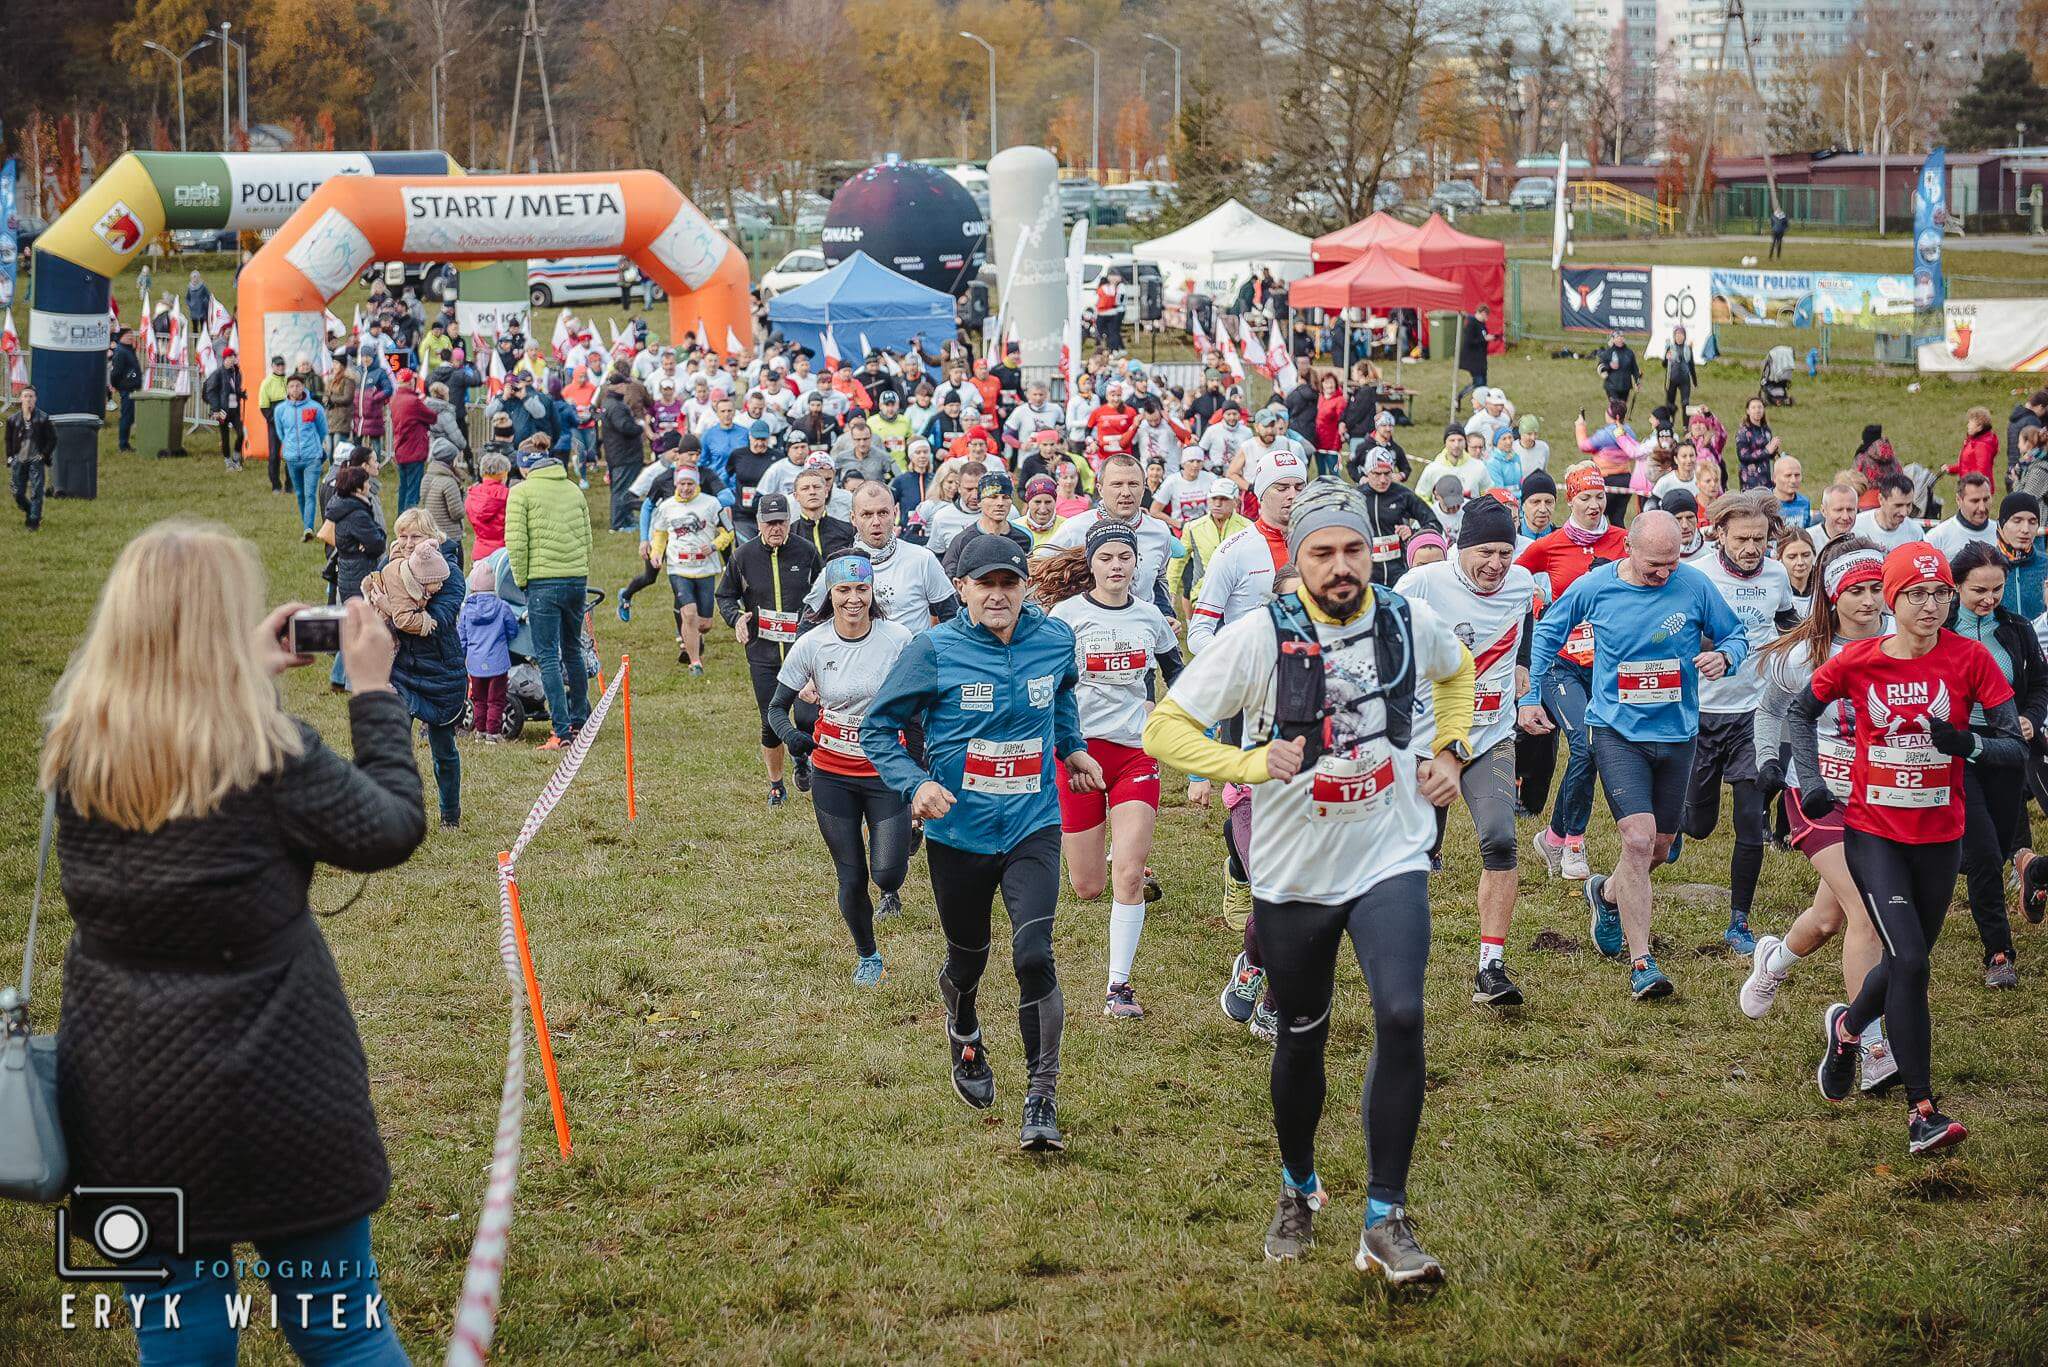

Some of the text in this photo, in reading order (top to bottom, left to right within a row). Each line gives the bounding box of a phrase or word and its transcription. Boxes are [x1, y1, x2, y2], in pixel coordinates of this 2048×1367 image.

[411, 196, 497, 219] START
[522, 192, 620, 218] META
[822, 226, 864, 242] CANAL+
[769, 622, 783, 631] 34
[1583, 628, 1593, 639] 8
[1103, 657, 1131, 671] 166
[1639, 677, 1659, 689] 29
[1886, 681, 1928, 698] RUN
[1887, 695, 1928, 706] POLAND
[839, 728, 859, 742] 50
[1887, 734, 1933, 748] TEAM
[994, 761, 1015, 777] 51
[1819, 760, 1851, 780] 152
[1895, 771, 1923, 788] 82
[1339, 777, 1377, 801] 179
